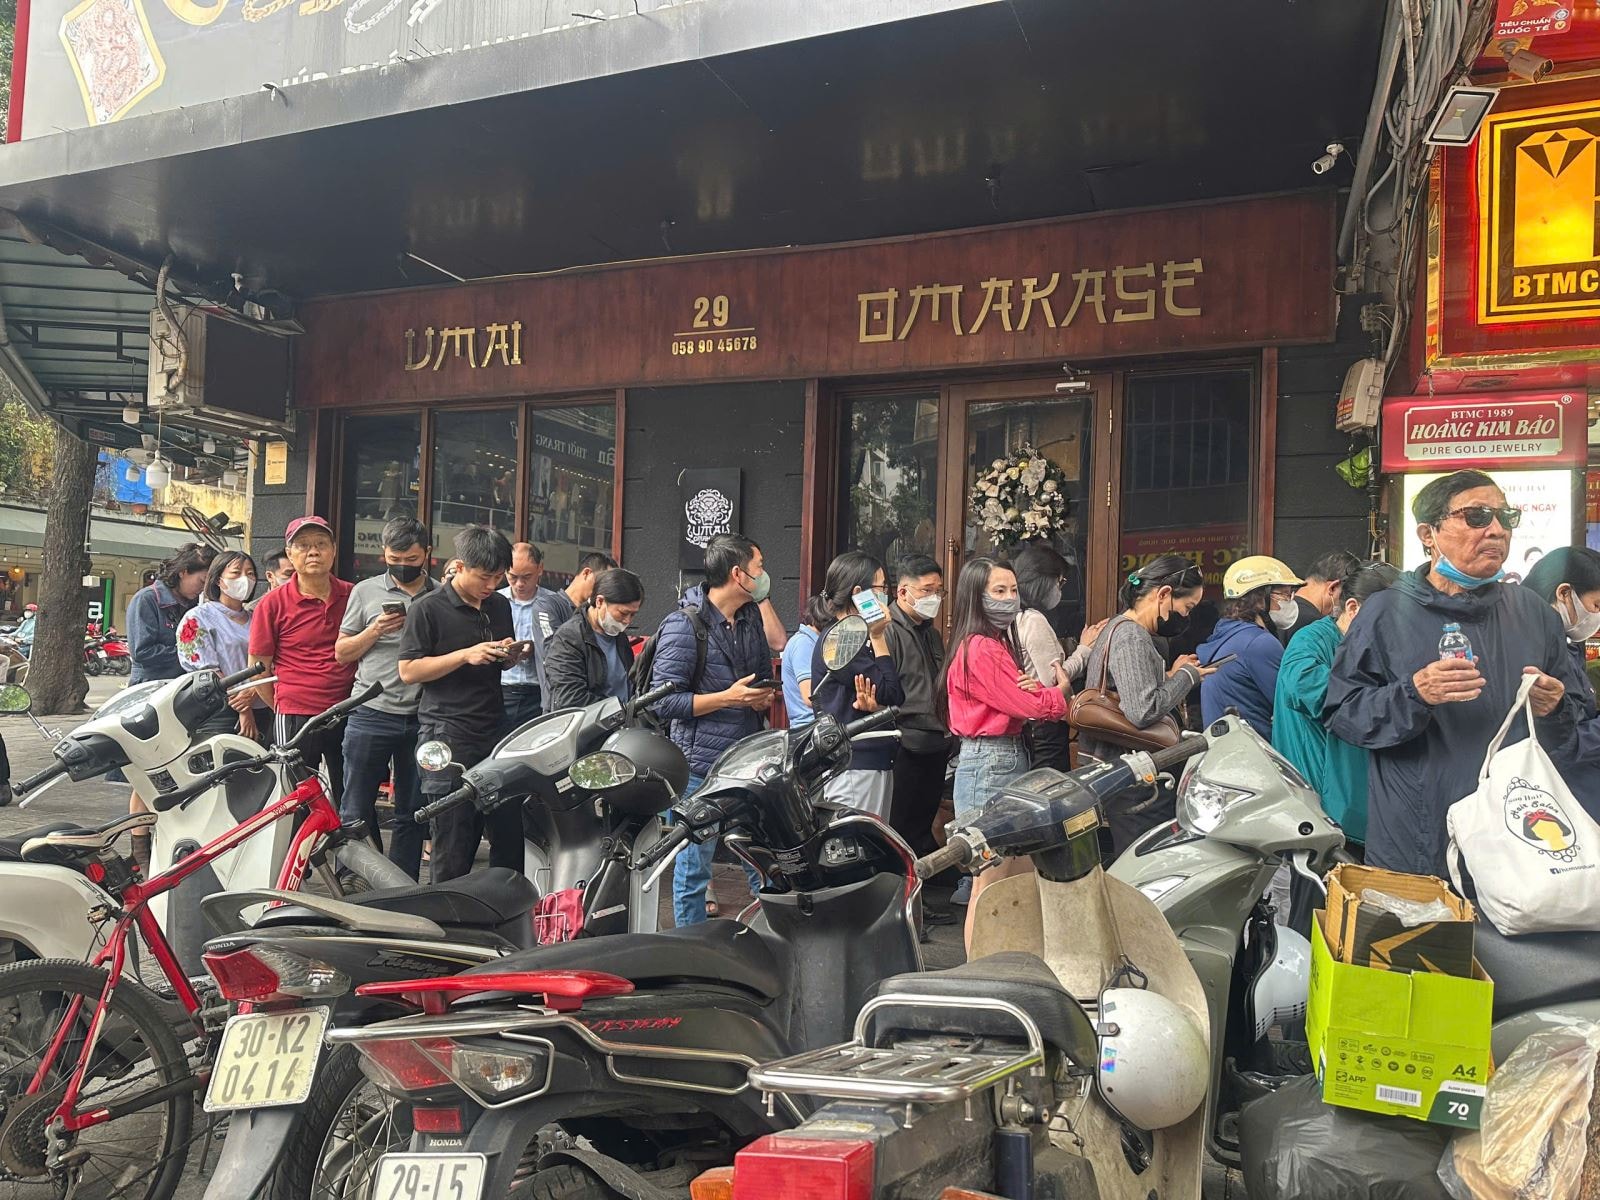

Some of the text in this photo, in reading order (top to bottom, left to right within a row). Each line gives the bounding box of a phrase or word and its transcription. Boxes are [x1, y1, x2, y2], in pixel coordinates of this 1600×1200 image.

[1513, 269, 1599, 298] BTMC
[857, 258, 1203, 343] OMAKASE
[693, 295, 729, 328] 29
[404, 320, 522, 372] UMAI
[672, 336, 757, 355] 058 90 45678
[1451, 408, 1514, 419] BTMC 1989
[1410, 414, 1556, 440] HOÀNG KIM BẢO
[1422, 443, 1543, 455] PURE GOLD JEWELRY
[1531, 503, 1556, 512] NGAY
[208, 941, 236, 951] HONDA
[233, 1015, 311, 1059] 30-K2
[1348, 1075, 1367, 1083] APP
[1452, 1064, 1477, 1078] A4
[221, 1057, 299, 1103] 0414
[1447, 1101, 1469, 1116] 70
[429, 1139, 463, 1147] HONDA
